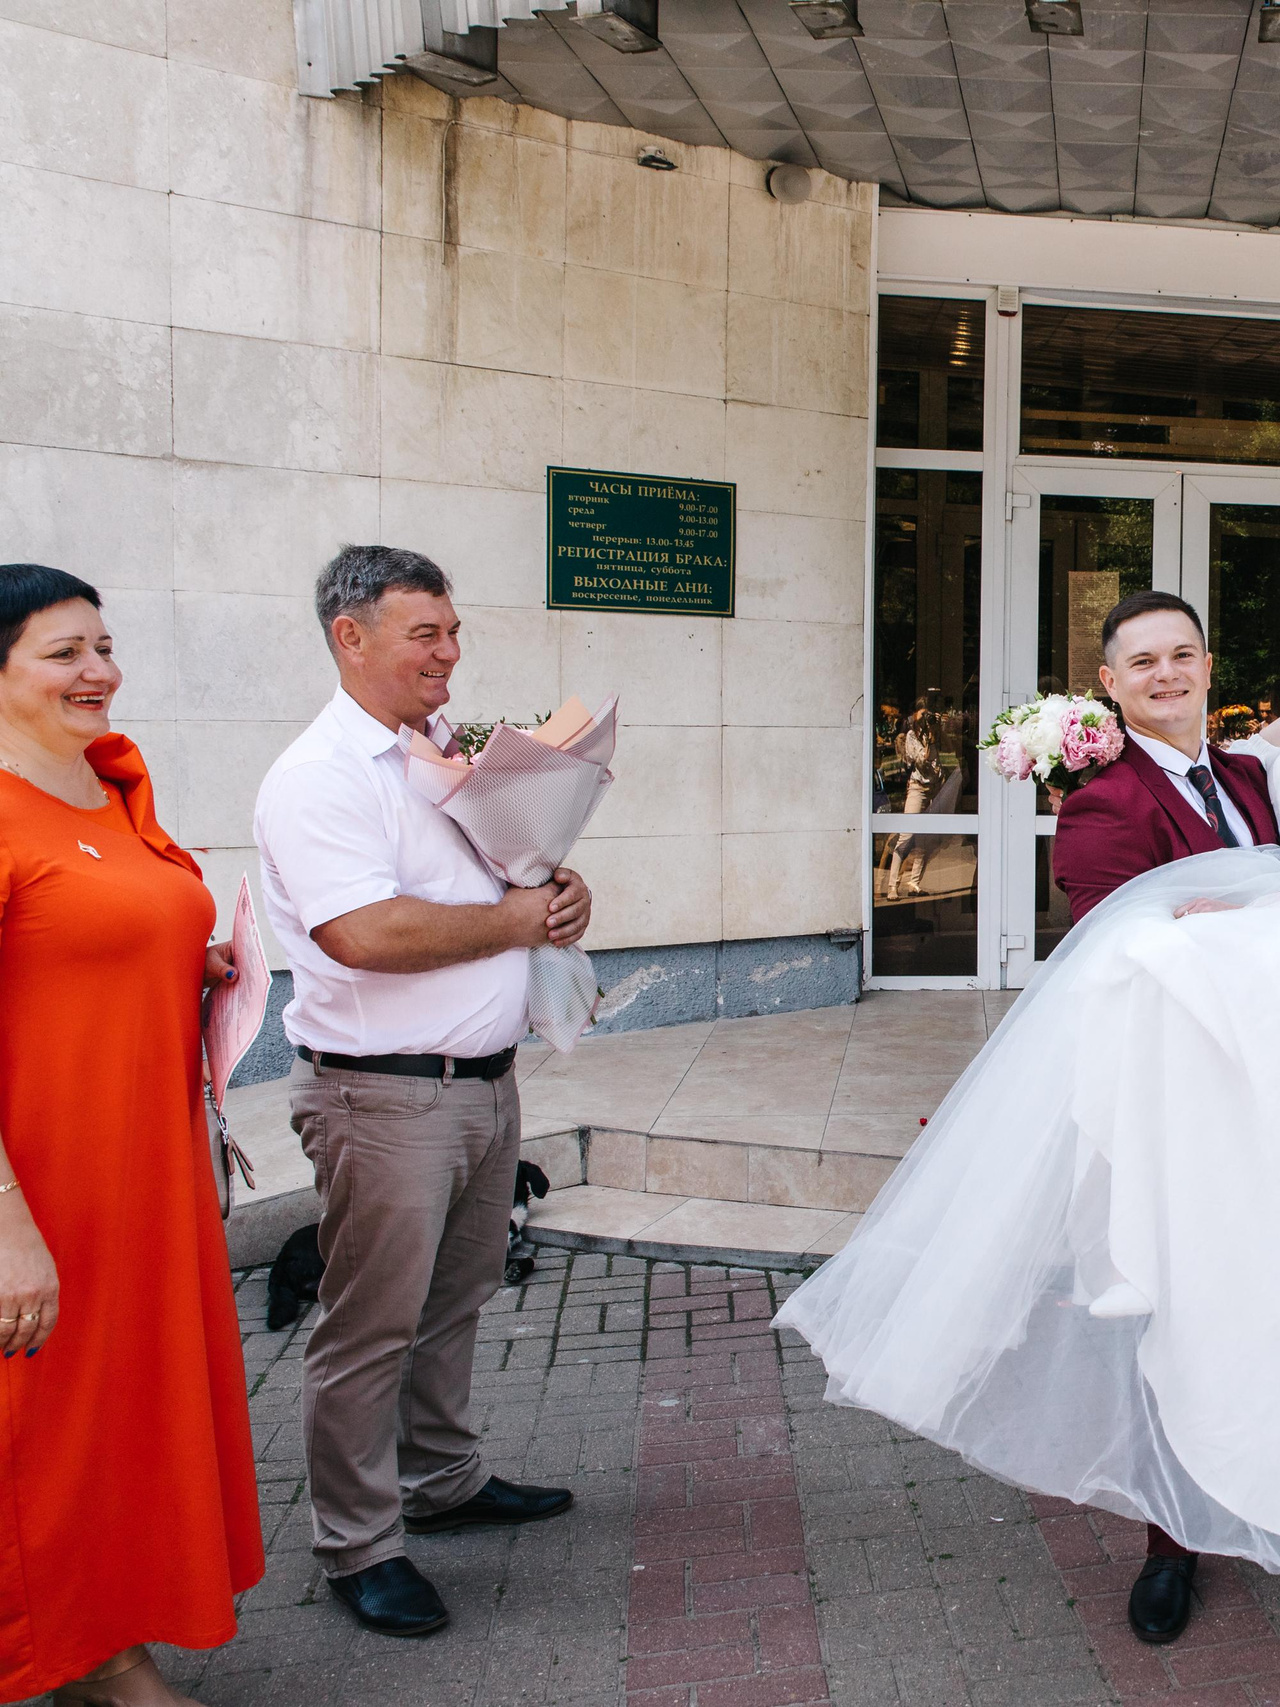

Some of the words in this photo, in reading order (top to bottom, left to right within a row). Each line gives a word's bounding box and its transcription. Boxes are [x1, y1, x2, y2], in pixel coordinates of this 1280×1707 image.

[590, 481, 632, 496] ЧАСЫ
[638, 485, 700, 501] ПРИЁМА:
[568, 494, 609, 504] вторник
[568, 506, 595, 516] среда
[679, 515, 718, 525] 9.00-13.00
[568, 521, 607, 531] четверг
[593, 535, 642, 545] перерыв:
[558, 546, 669, 564] РЕГИСТРАЦИЯ
[676, 554, 727, 567] БРАКА:
[596, 564, 646, 573] пятница,
[651, 566, 692, 576] суббота
[574, 576, 668, 591] ВЫХОДНЫЕ
[674, 583, 713, 594] ДНИ:
[572, 592, 641, 602] воскресенье,
[646, 596, 713, 604] понедельник
